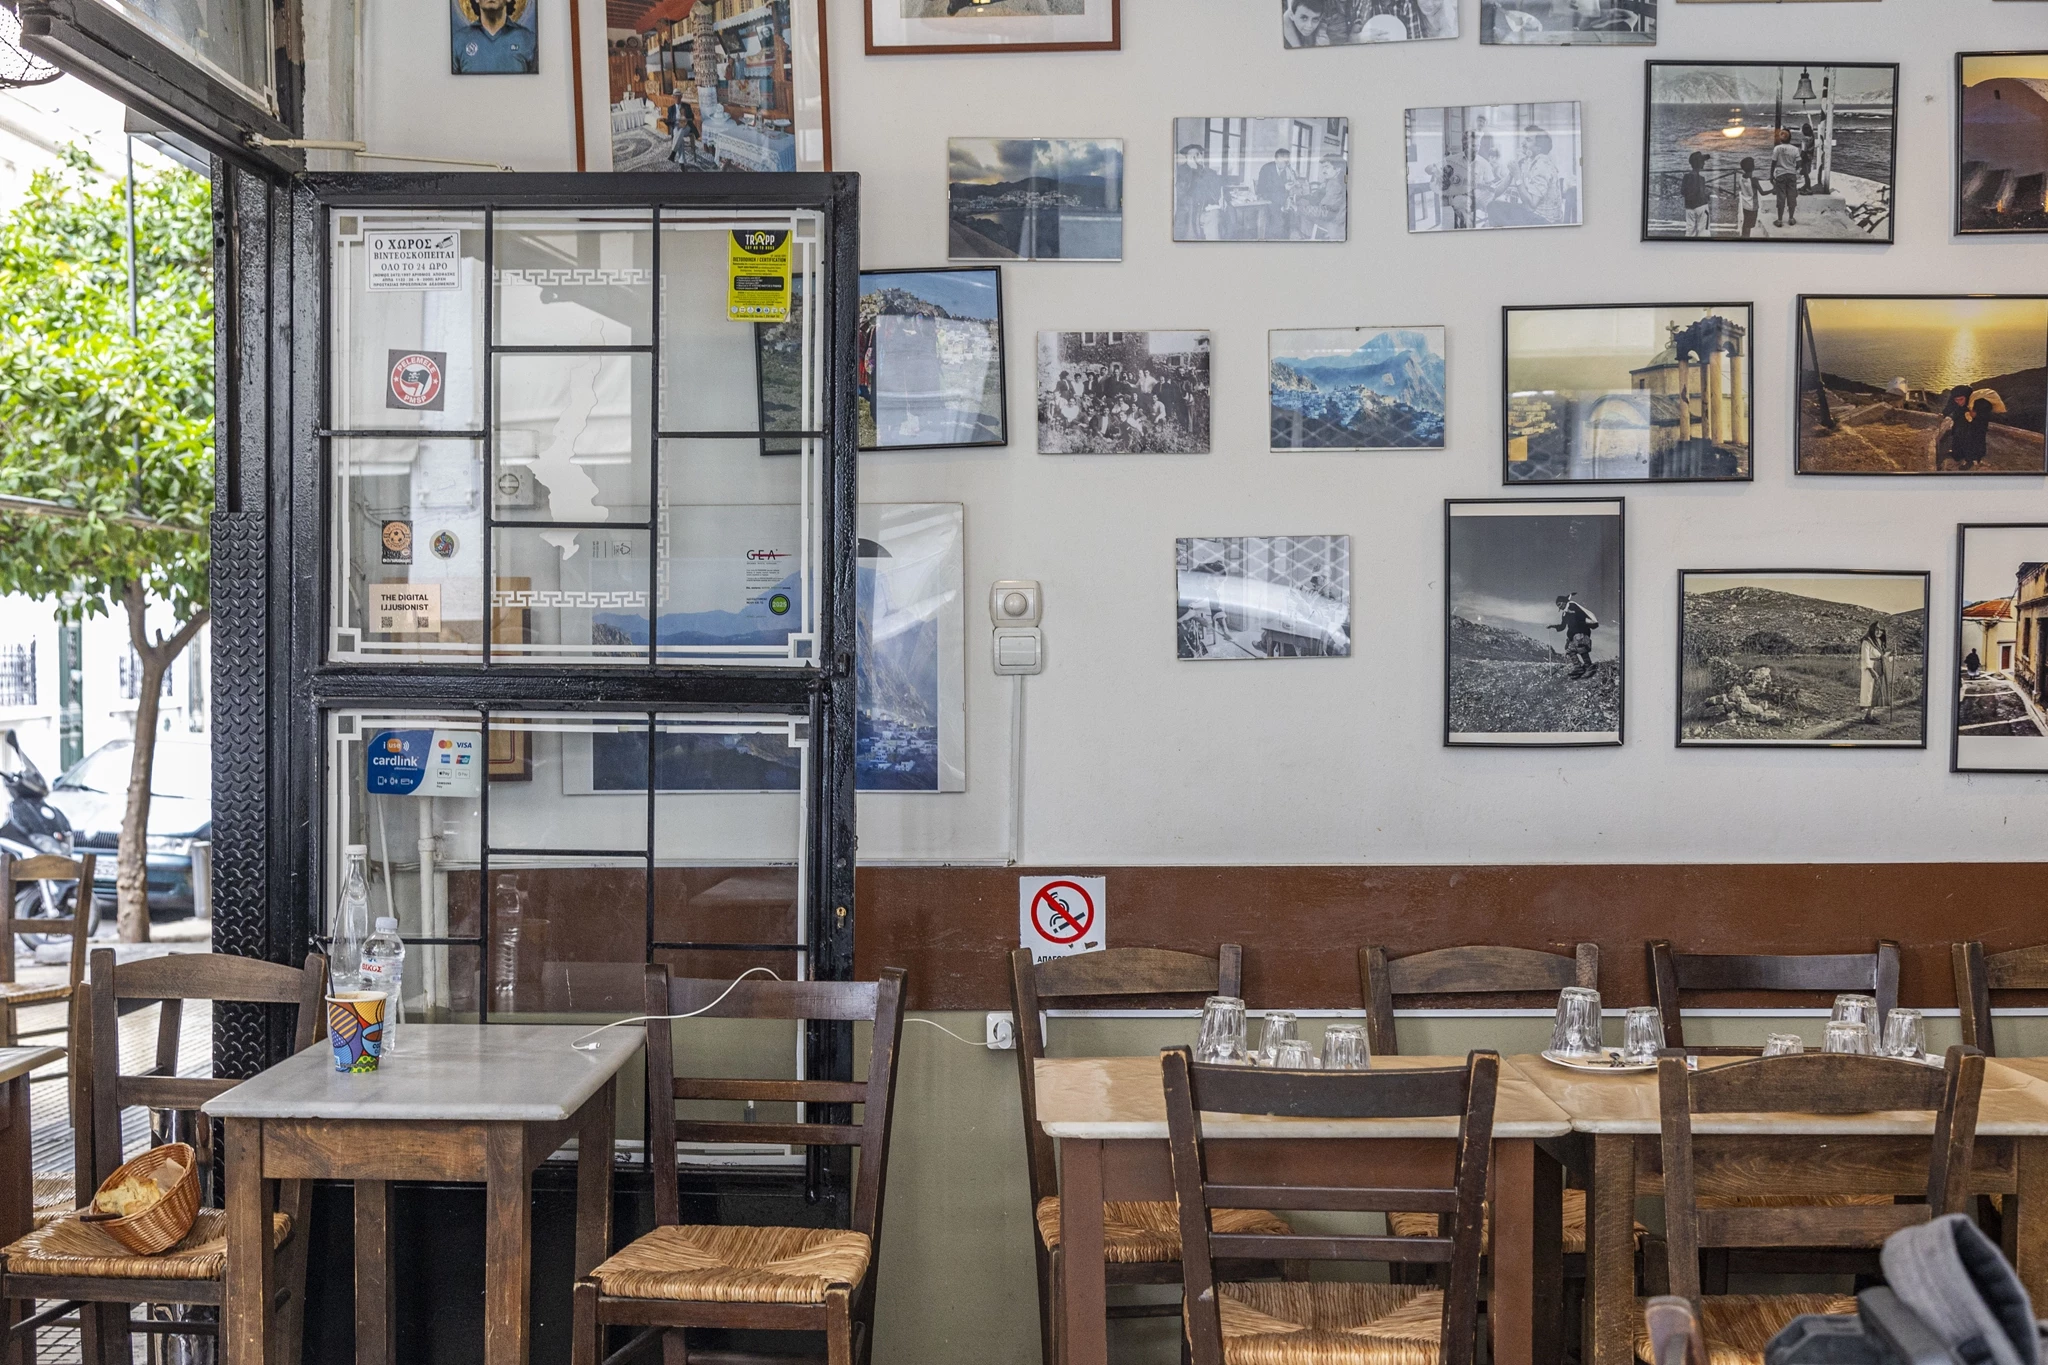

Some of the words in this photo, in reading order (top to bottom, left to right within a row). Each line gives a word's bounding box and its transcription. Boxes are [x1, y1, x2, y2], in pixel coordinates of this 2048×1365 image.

[375, 240, 383, 250] Ο
[388, 239, 432, 250] ΧΩΡΟΣ
[745, 234, 775, 246] TRAPP
[374, 252, 454, 260] ΒΙΝΤΕΟΣΚΟΠΕΙΤΑΙ
[397, 356, 436, 374] PELEMELE
[404, 395, 426, 404] PMSP
[747, 550, 776, 560] GEA
[373, 756, 417, 766] cardlink
